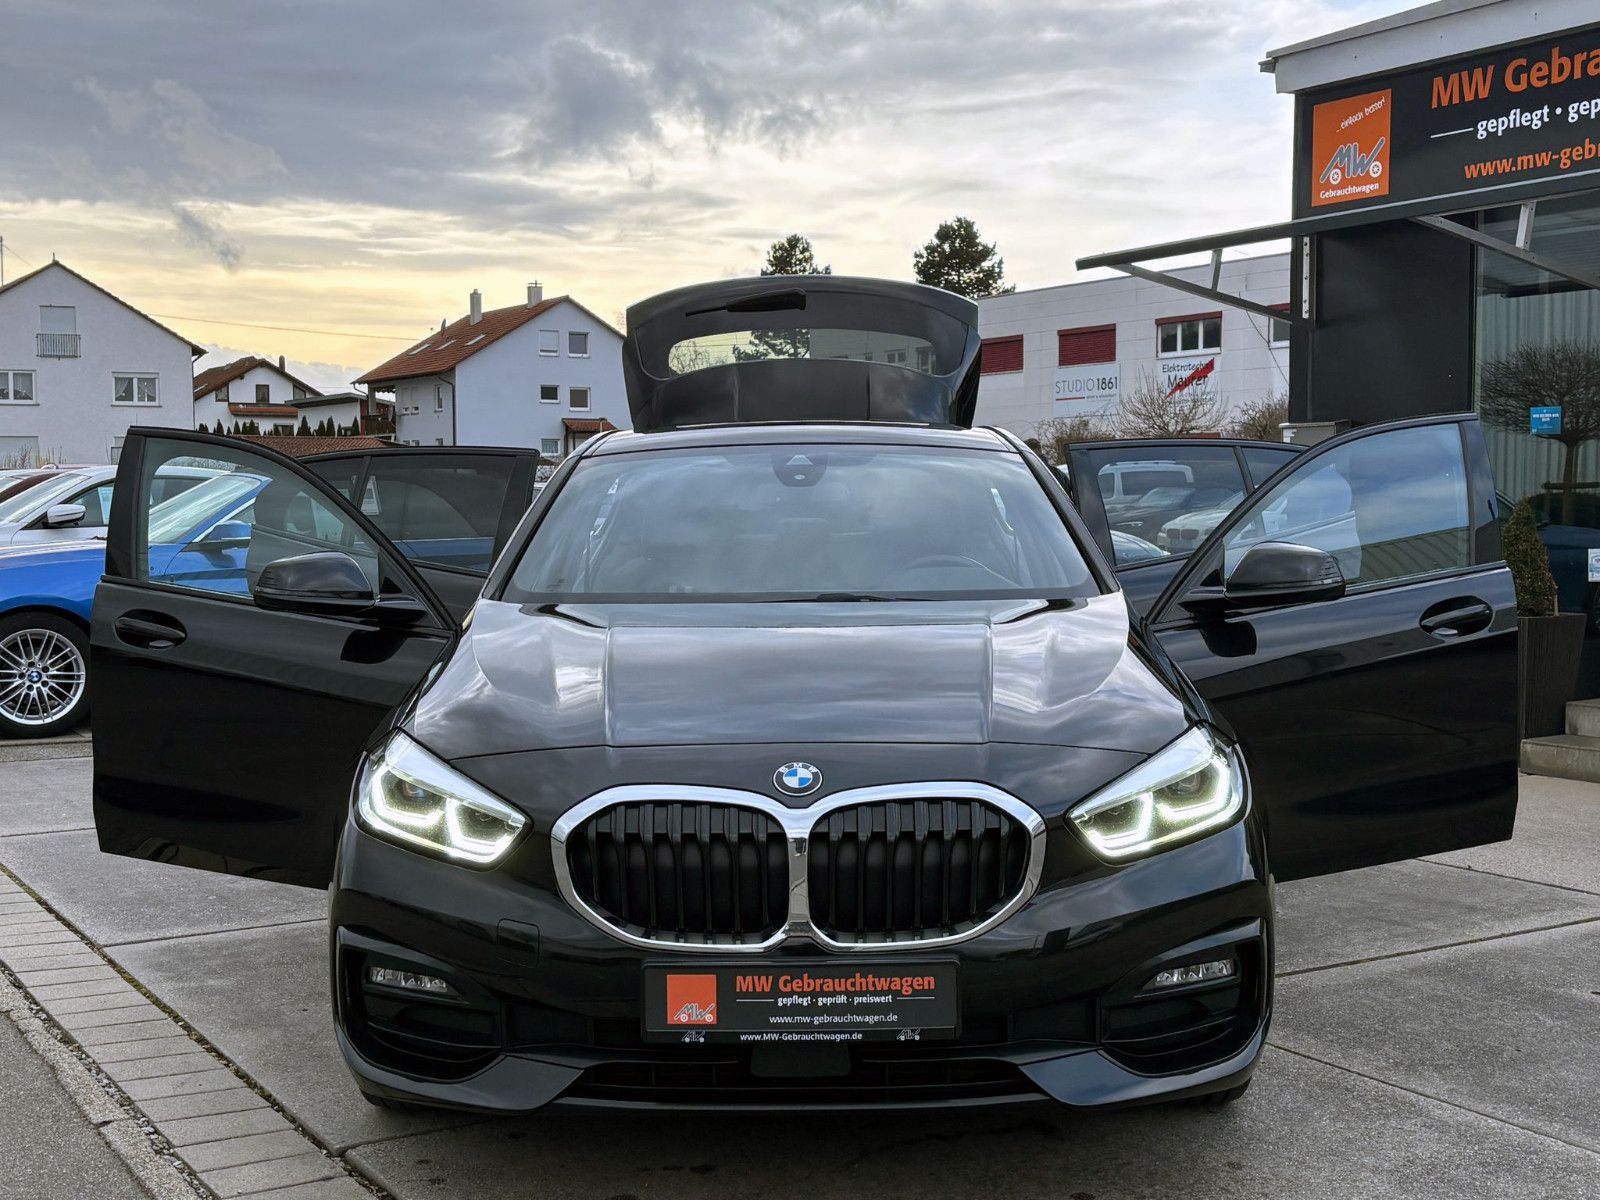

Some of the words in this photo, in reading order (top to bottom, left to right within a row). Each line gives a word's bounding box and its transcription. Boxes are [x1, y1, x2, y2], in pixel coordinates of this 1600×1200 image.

[1431, 64, 1496, 109] MW
[1504, 46, 1600, 93] Gebra
[1477, 104, 1550, 140] gepflegt
[1464, 137, 1600, 179] www.mw-geb
[1320, 182, 1380, 199] Gebrauchtwagen
[736, 975, 773, 993] MW
[778, 972, 935, 996] Gebrauchtwagen
[777, 995, 811, 1007] gepflegt
[817, 994, 847, 1007] geprüft
[854, 994, 892, 1005] preiswert
[769, 1013, 898, 1025] www.mw-gebrauchtwagen.de
[740, 1032, 863, 1042] www.MW-Gebrauchtwagen.de
